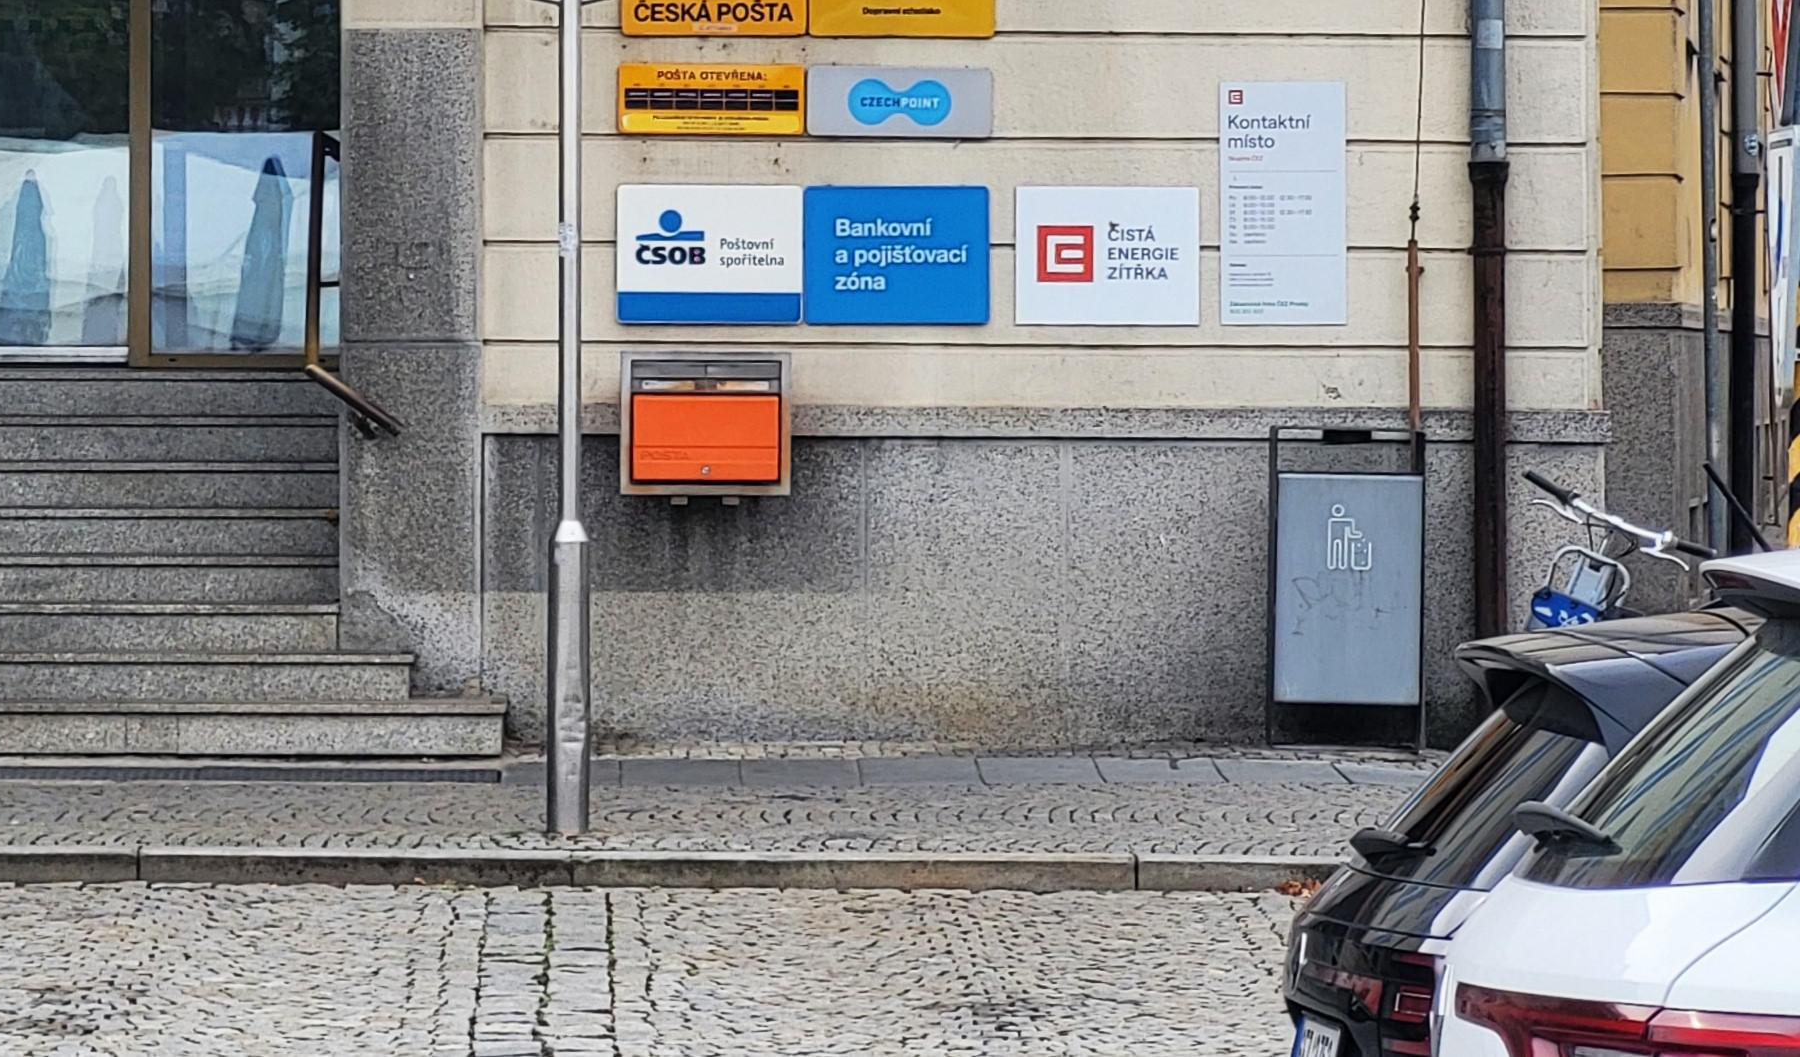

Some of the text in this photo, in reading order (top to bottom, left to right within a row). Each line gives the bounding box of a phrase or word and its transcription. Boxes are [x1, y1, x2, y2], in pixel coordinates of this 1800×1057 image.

[634, 0, 794, 23] ČESKÁ POŠTA
[657, 69, 696, 80] POŠTA
[1228, 114, 1311, 131] Kontaktní
[1228, 134, 1276, 149] místo
[835, 217, 932, 237] Bankovní
[1107, 221, 1156, 242] ČISTÁ
[719, 237, 775, 251] Poštovní
[636, 242, 707, 265] ČSOB
[719, 253, 785, 268] spořitelna
[835, 244, 968, 268] a pojišťovací
[1107, 247, 1180, 261] ENERGIE
[1107, 263, 1169, 281] ZÍTŘKA
[834, 272, 887, 291] zóna
